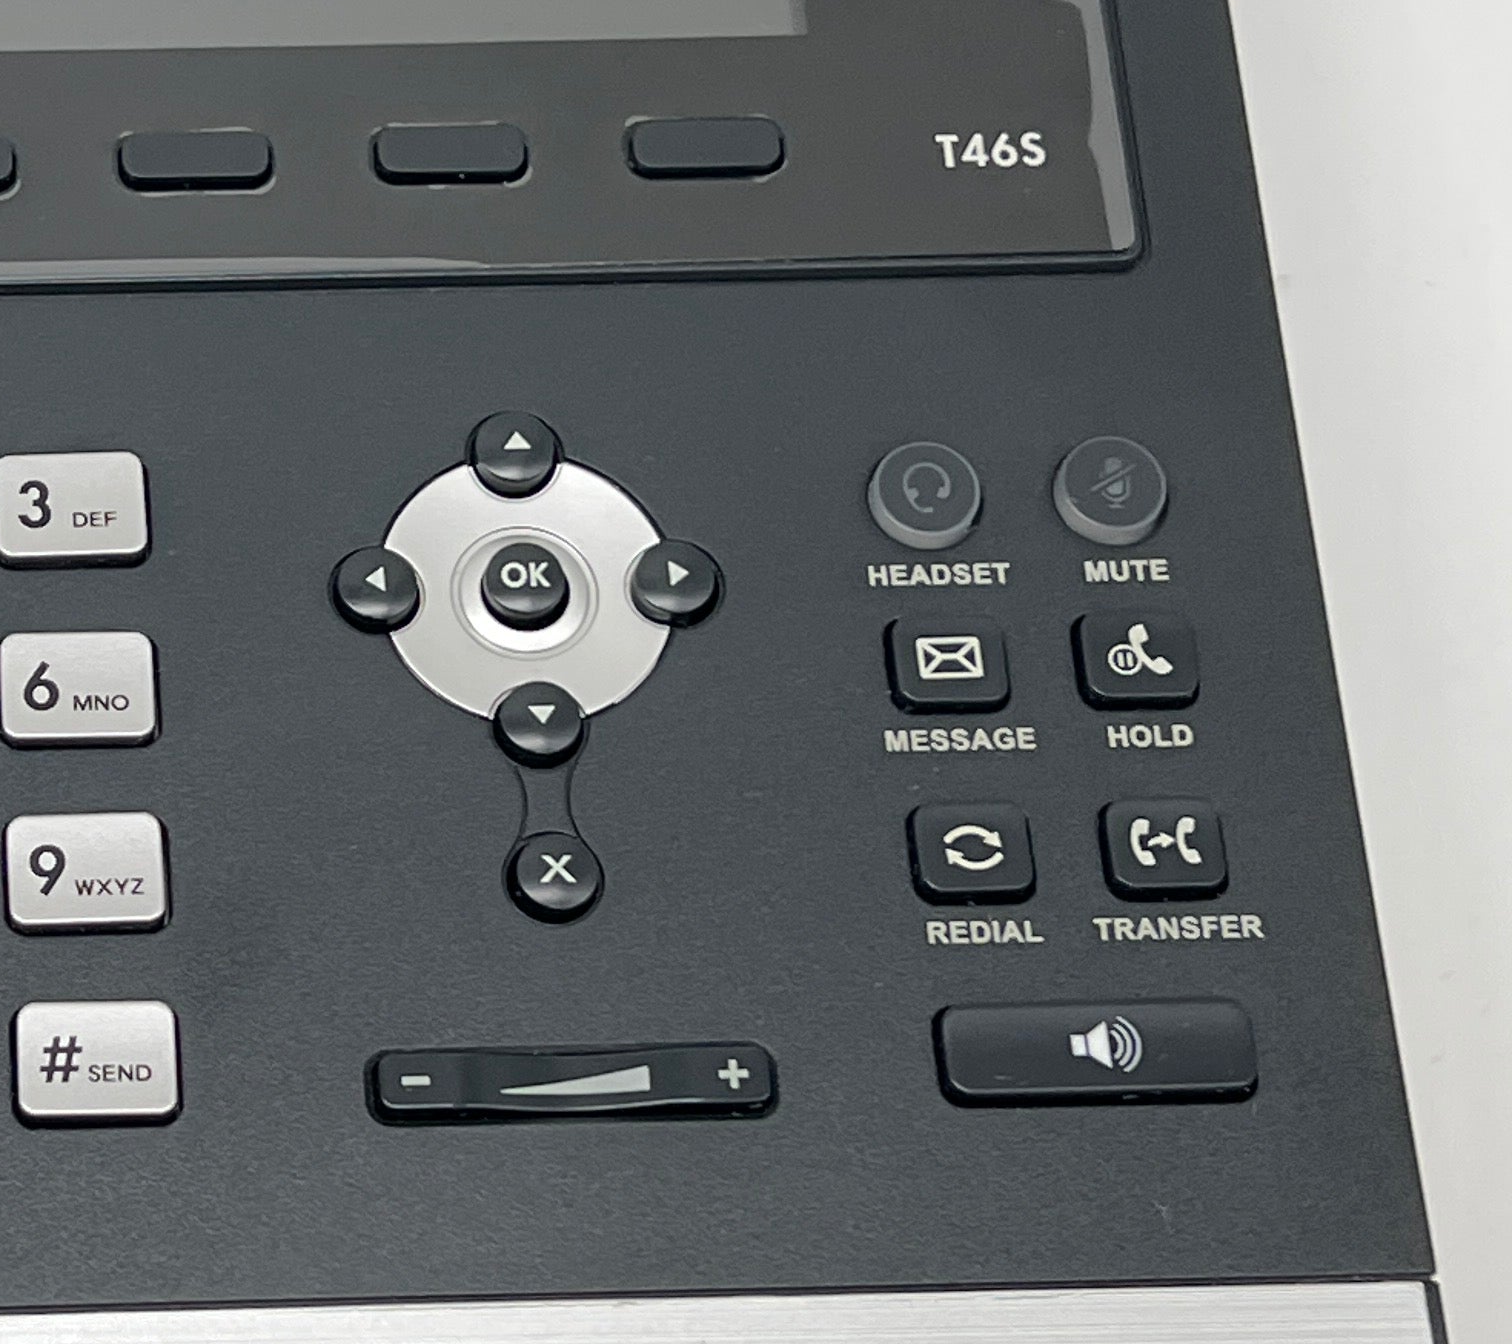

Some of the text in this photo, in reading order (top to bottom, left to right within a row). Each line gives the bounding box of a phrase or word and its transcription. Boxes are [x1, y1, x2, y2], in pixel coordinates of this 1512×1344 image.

[935, 132, 1046, 168] T46S
[18, 480, 117, 529] 3 DEF
[500, 561, 551, 589] OK
[867, 562, 1010, 587] HEADSET
[1084, 558, 1170, 582] MUTE
[23, 661, 130, 711] 6 MNO
[884, 726, 1037, 752] MESSAGE
[1107, 724, 1194, 748] HOLD
[29, 845, 145, 896] 9 WXYZ
[926, 919, 1045, 944] REDIAL
[1092, 914, 1265, 941] TRANSFER
[39, 1035, 152, 1084] # SEND
